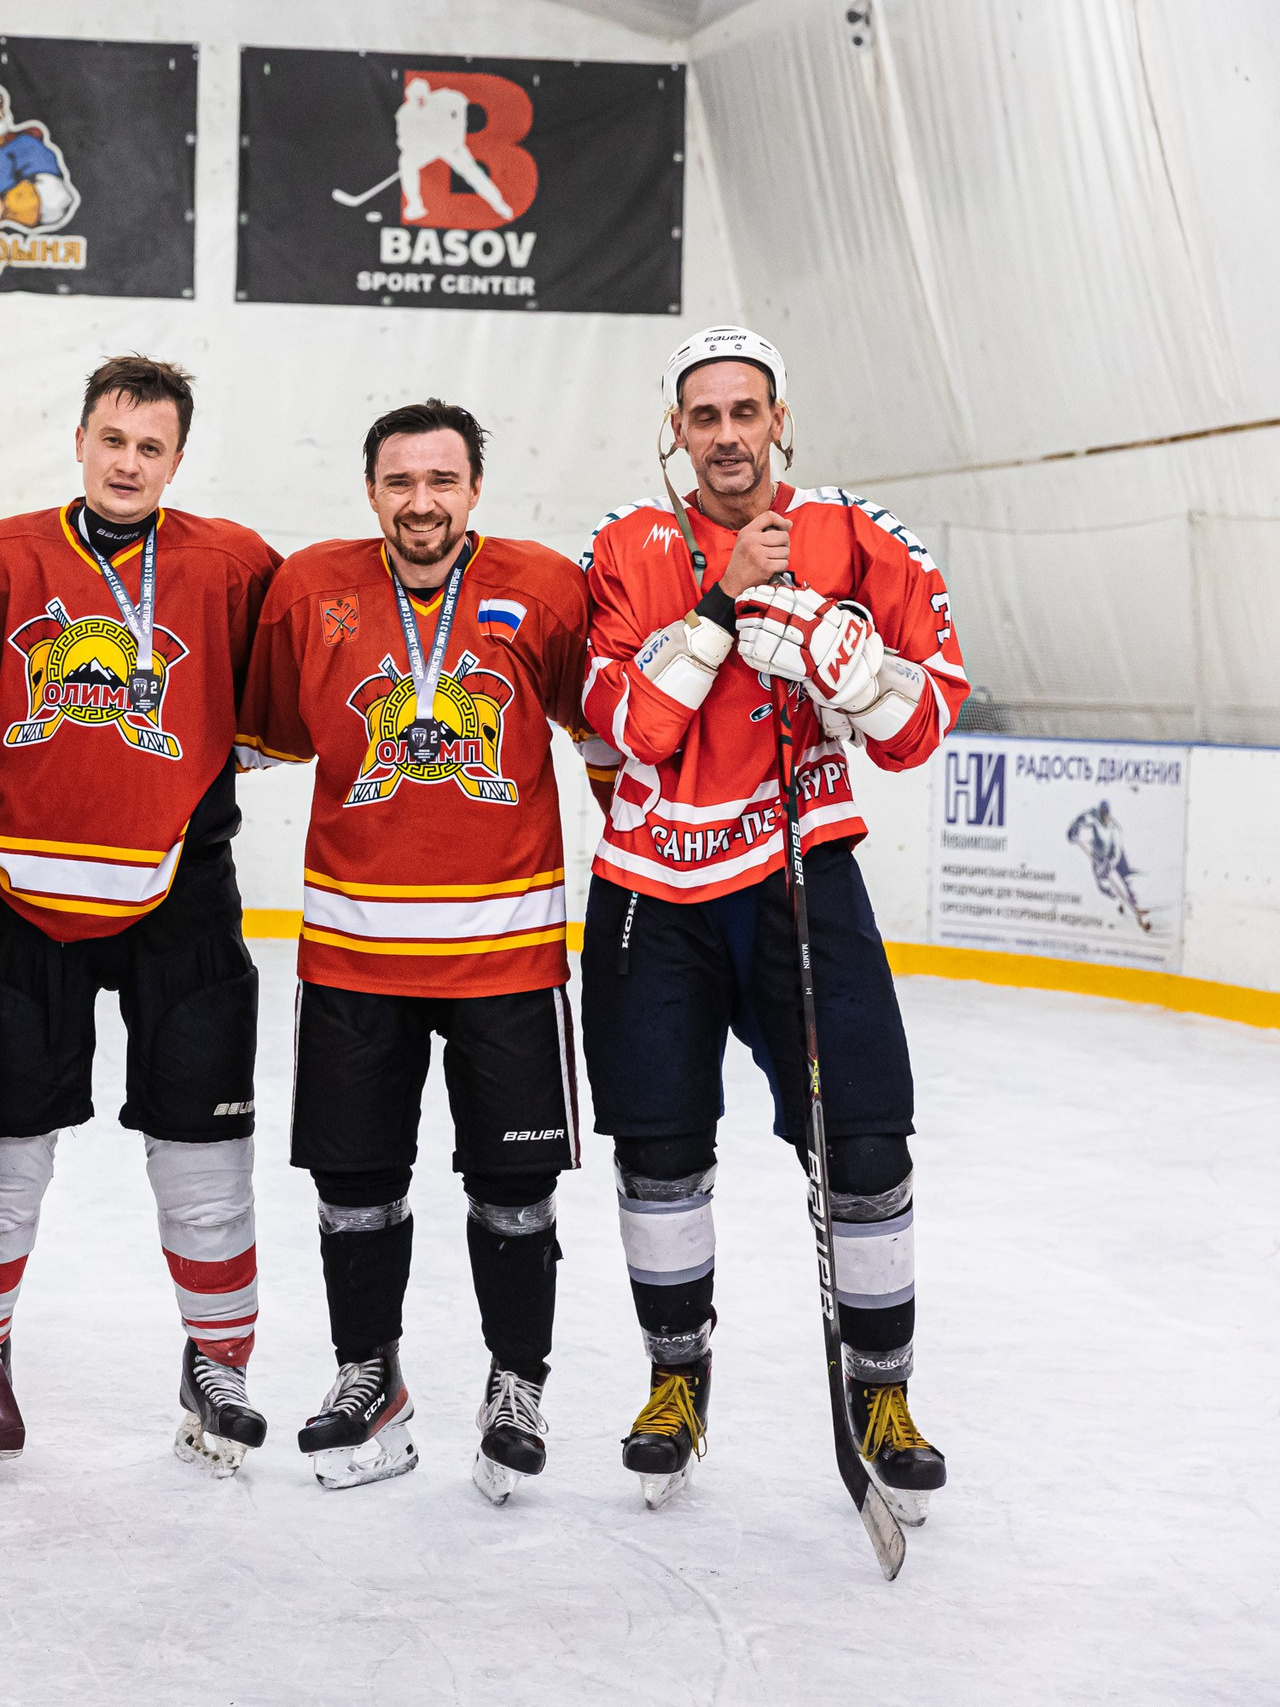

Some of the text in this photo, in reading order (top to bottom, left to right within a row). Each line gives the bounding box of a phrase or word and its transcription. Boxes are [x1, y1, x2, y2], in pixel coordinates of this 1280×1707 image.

[380, 227, 537, 268] BASOV
[356, 271, 536, 297] SPORT CENTER
[43, 682, 134, 712] ОЛИМ
[150, 681, 158, 694] 2
[430, 730, 438, 744] 2
[1016, 754, 1182, 786] РАДОСТЬ ДВИЖЕНИЯ
[503, 1128, 565, 1141] BAUER
[363, 1392, 386, 1422] CCM
